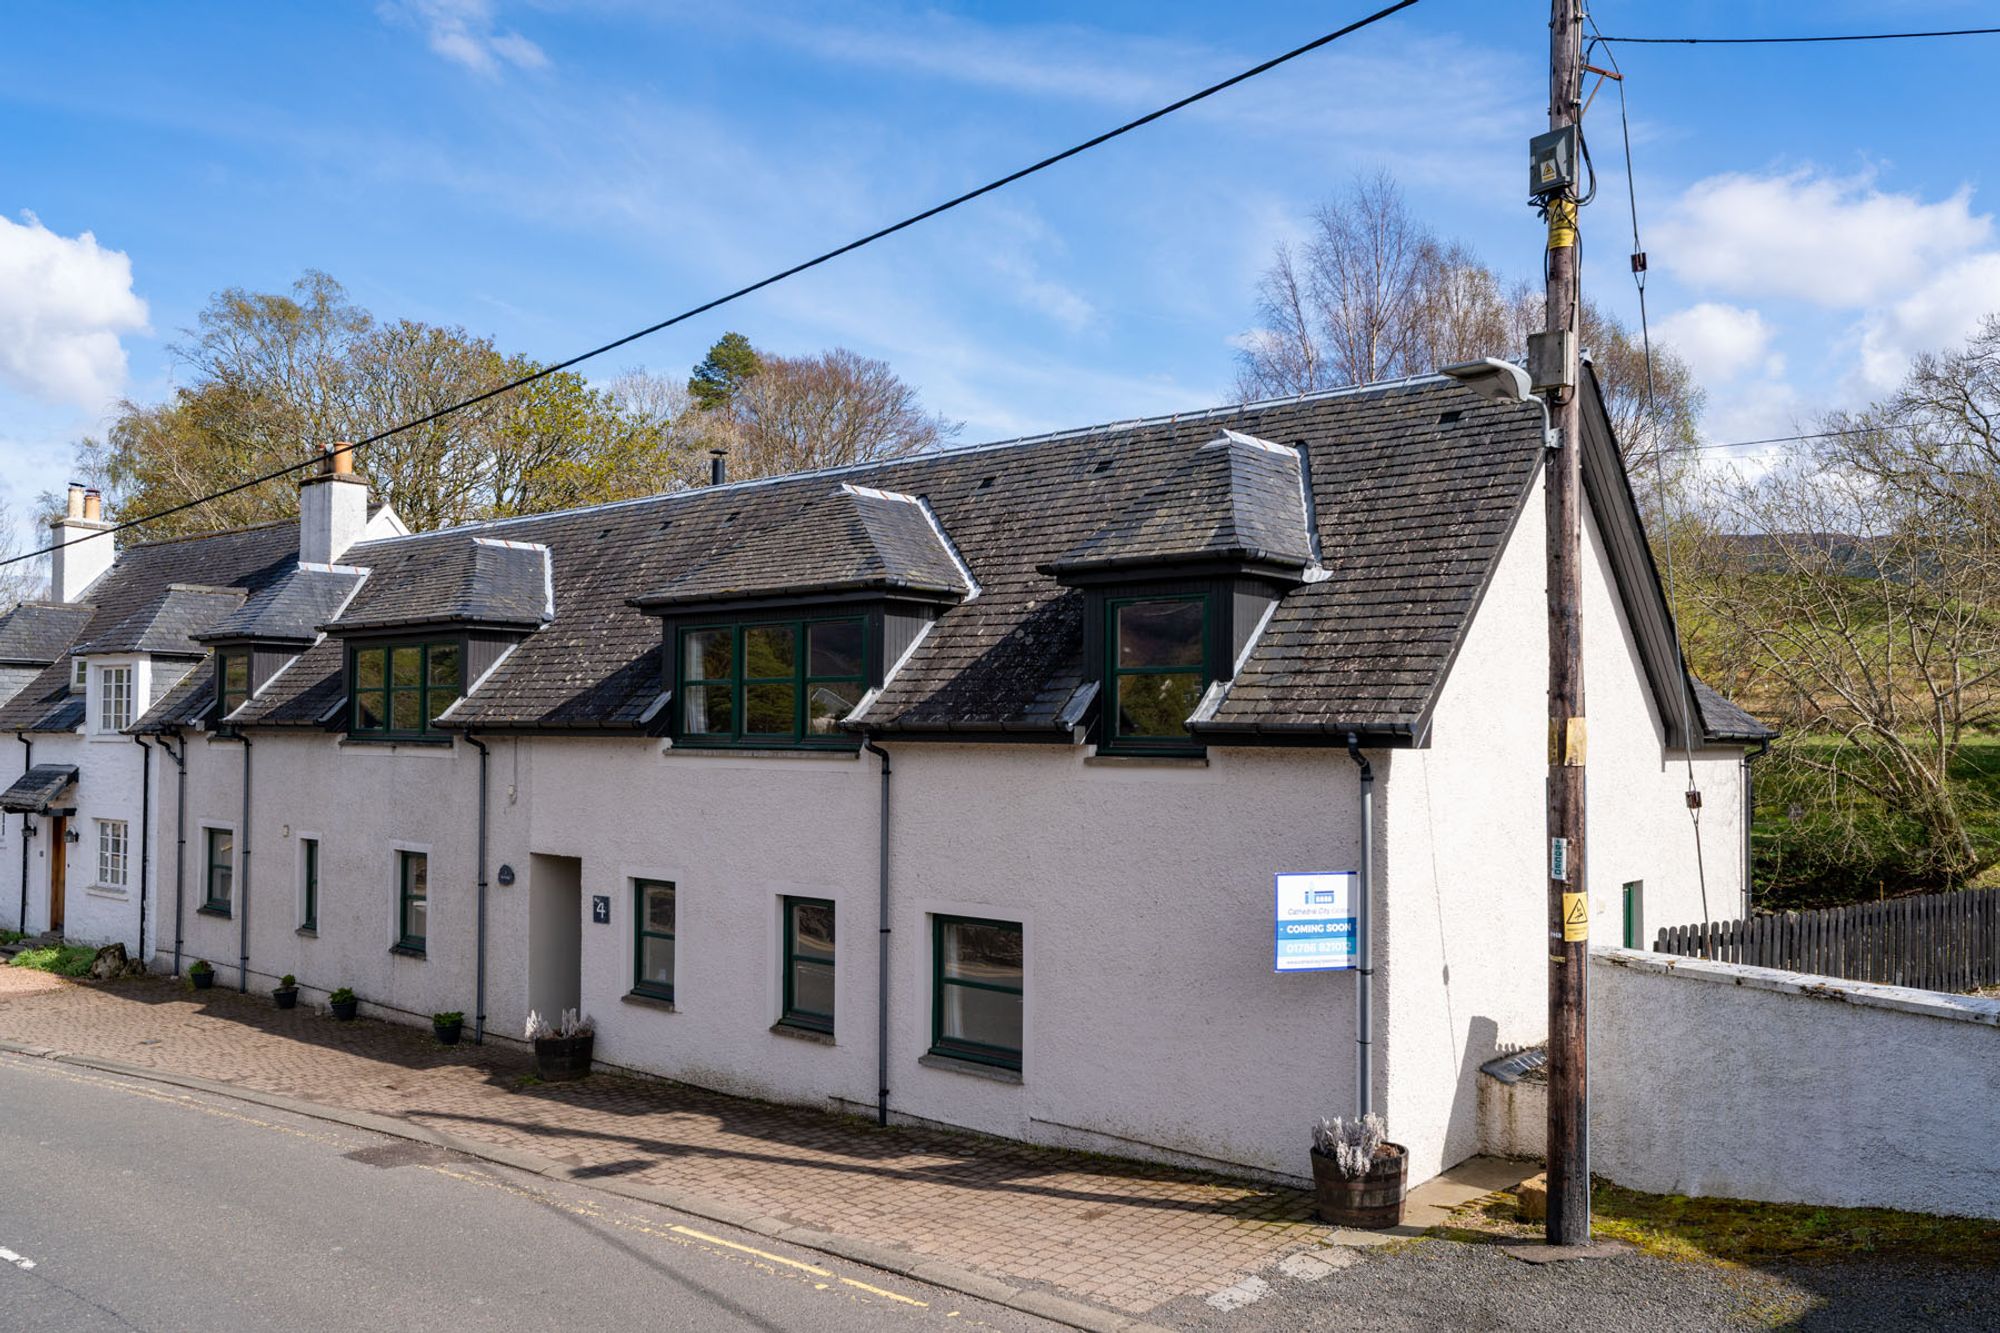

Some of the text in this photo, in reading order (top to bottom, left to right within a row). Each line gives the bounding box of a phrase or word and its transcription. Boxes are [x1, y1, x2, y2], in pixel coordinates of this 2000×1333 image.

[597, 902, 605, 918] 4
[1287, 923, 1351, 933] COMING SOON
